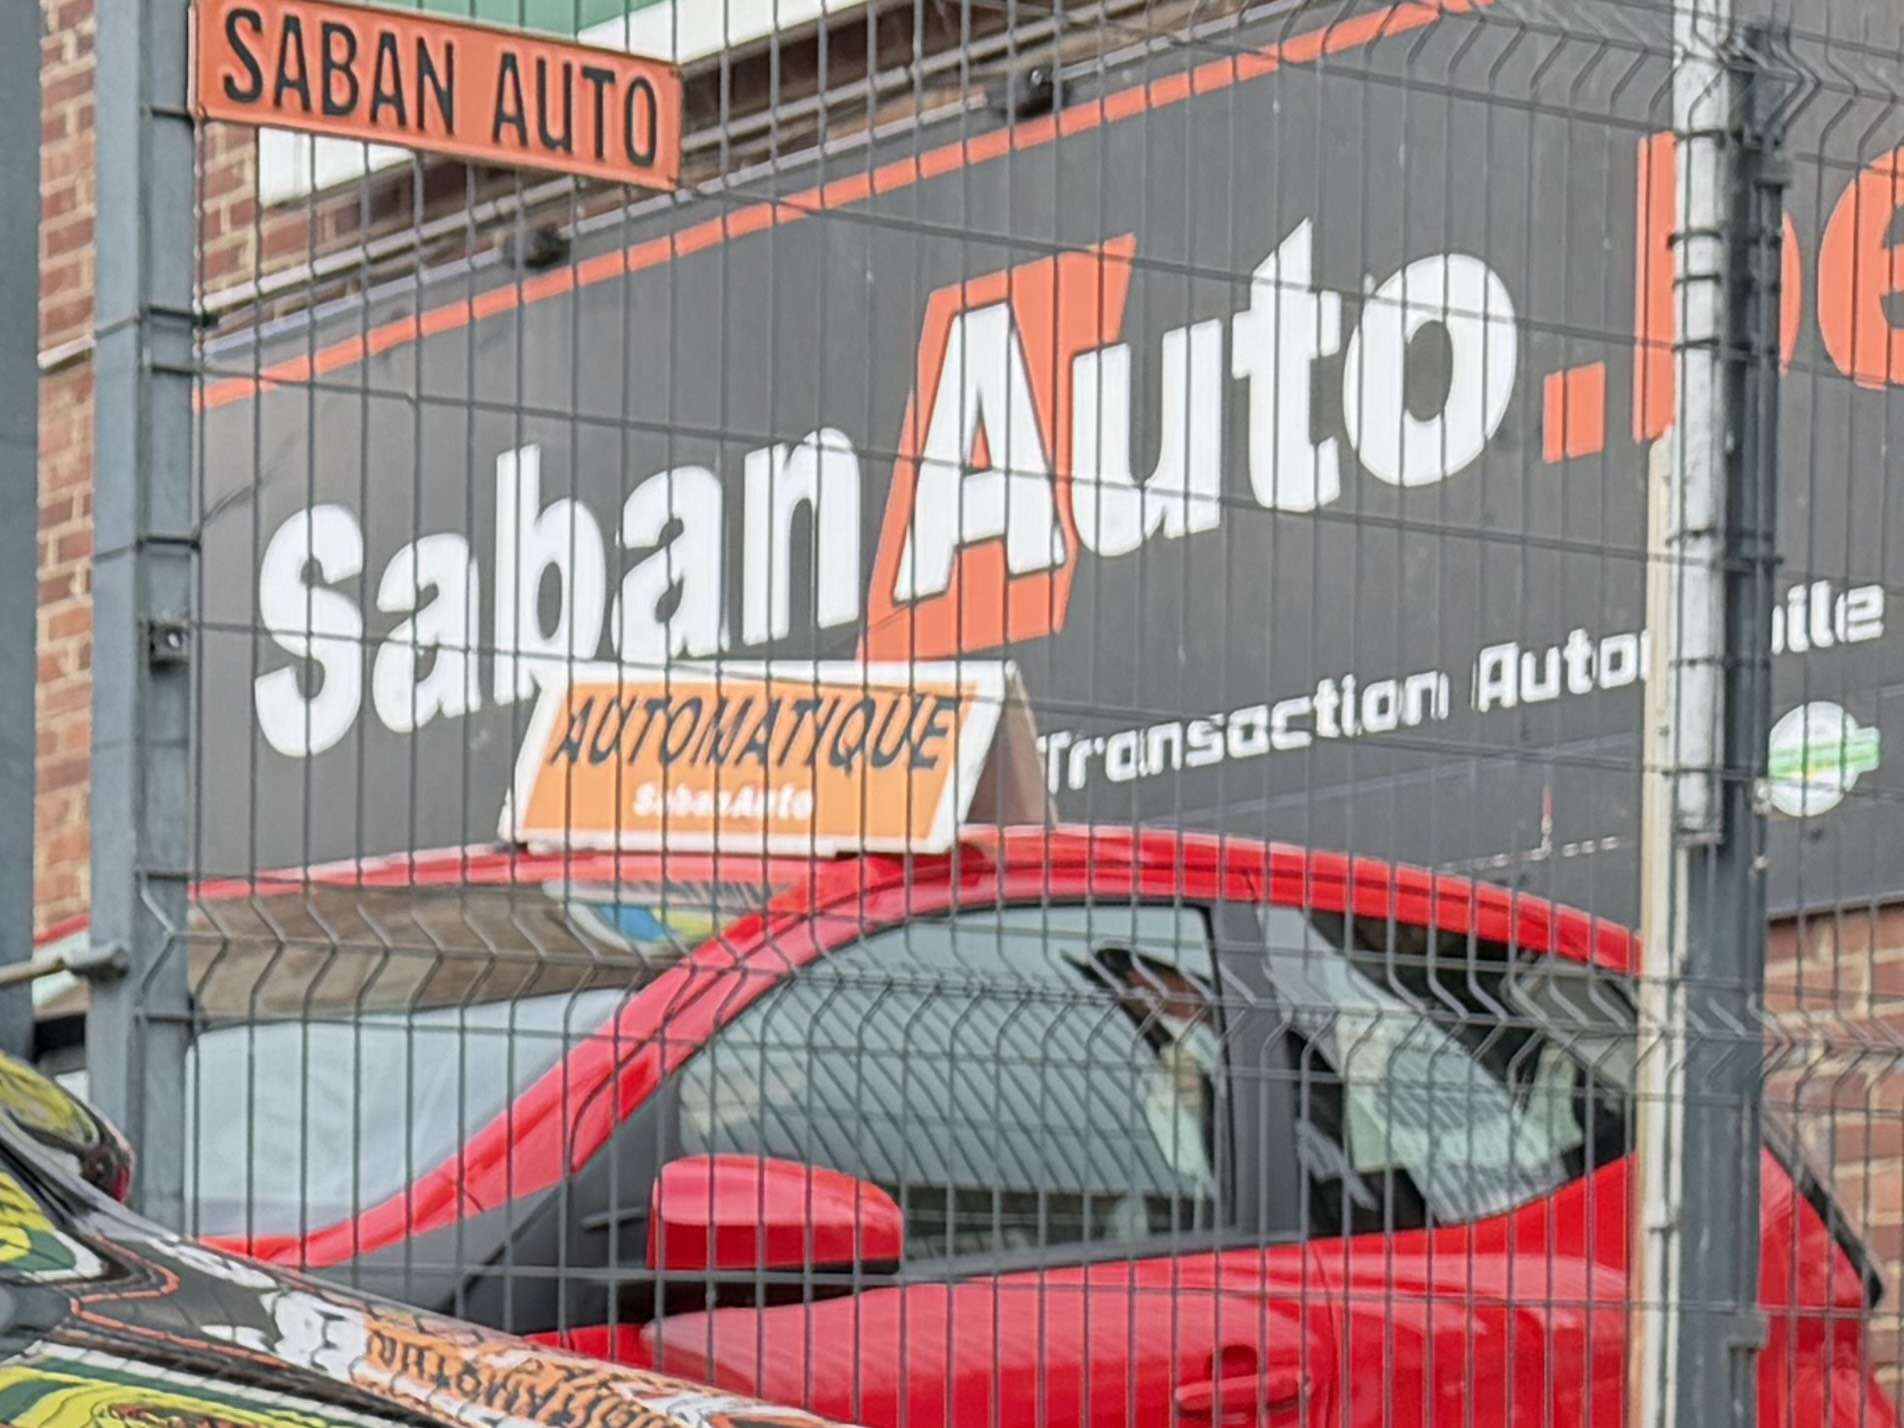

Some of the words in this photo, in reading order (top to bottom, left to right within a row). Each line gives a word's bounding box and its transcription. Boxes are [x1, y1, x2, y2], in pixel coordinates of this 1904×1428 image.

[222, 6, 456, 136] SABAN
[491, 51, 659, 168] AUTO
[548, 692, 963, 777] AUTOMATIQUE
[1036, 671, 1450, 794] Transaction
[1471, 580, 1885, 712] Autoile
